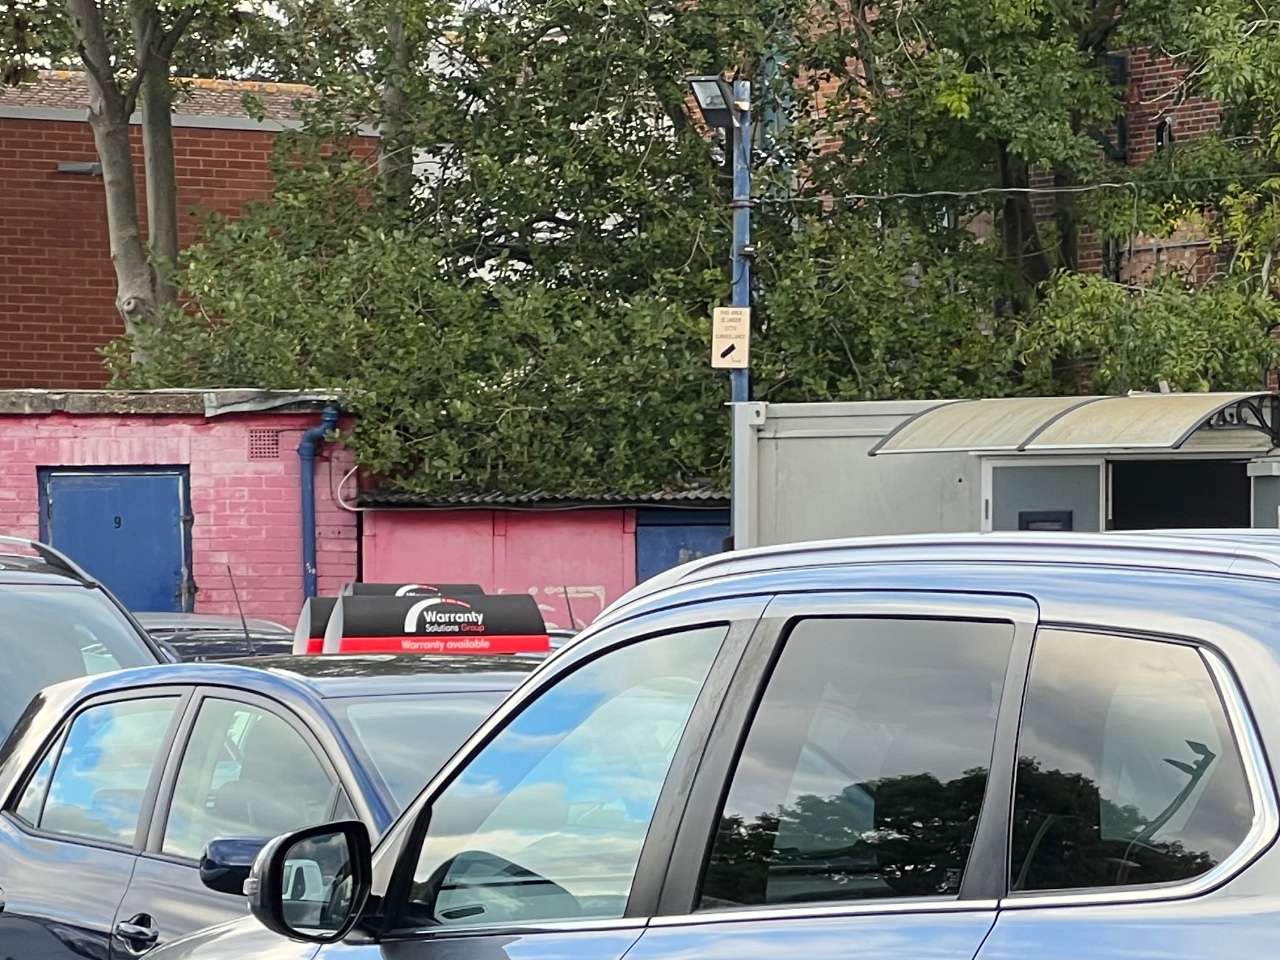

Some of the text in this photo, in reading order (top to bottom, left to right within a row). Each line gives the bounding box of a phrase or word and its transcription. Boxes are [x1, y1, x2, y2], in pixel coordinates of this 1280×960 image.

[113, 515, 122, 529] 9
[423, 610, 484, 626] Warranty
[425, 623, 485, 633] Solutions Group
[400, 638, 490, 653] Warranty available
